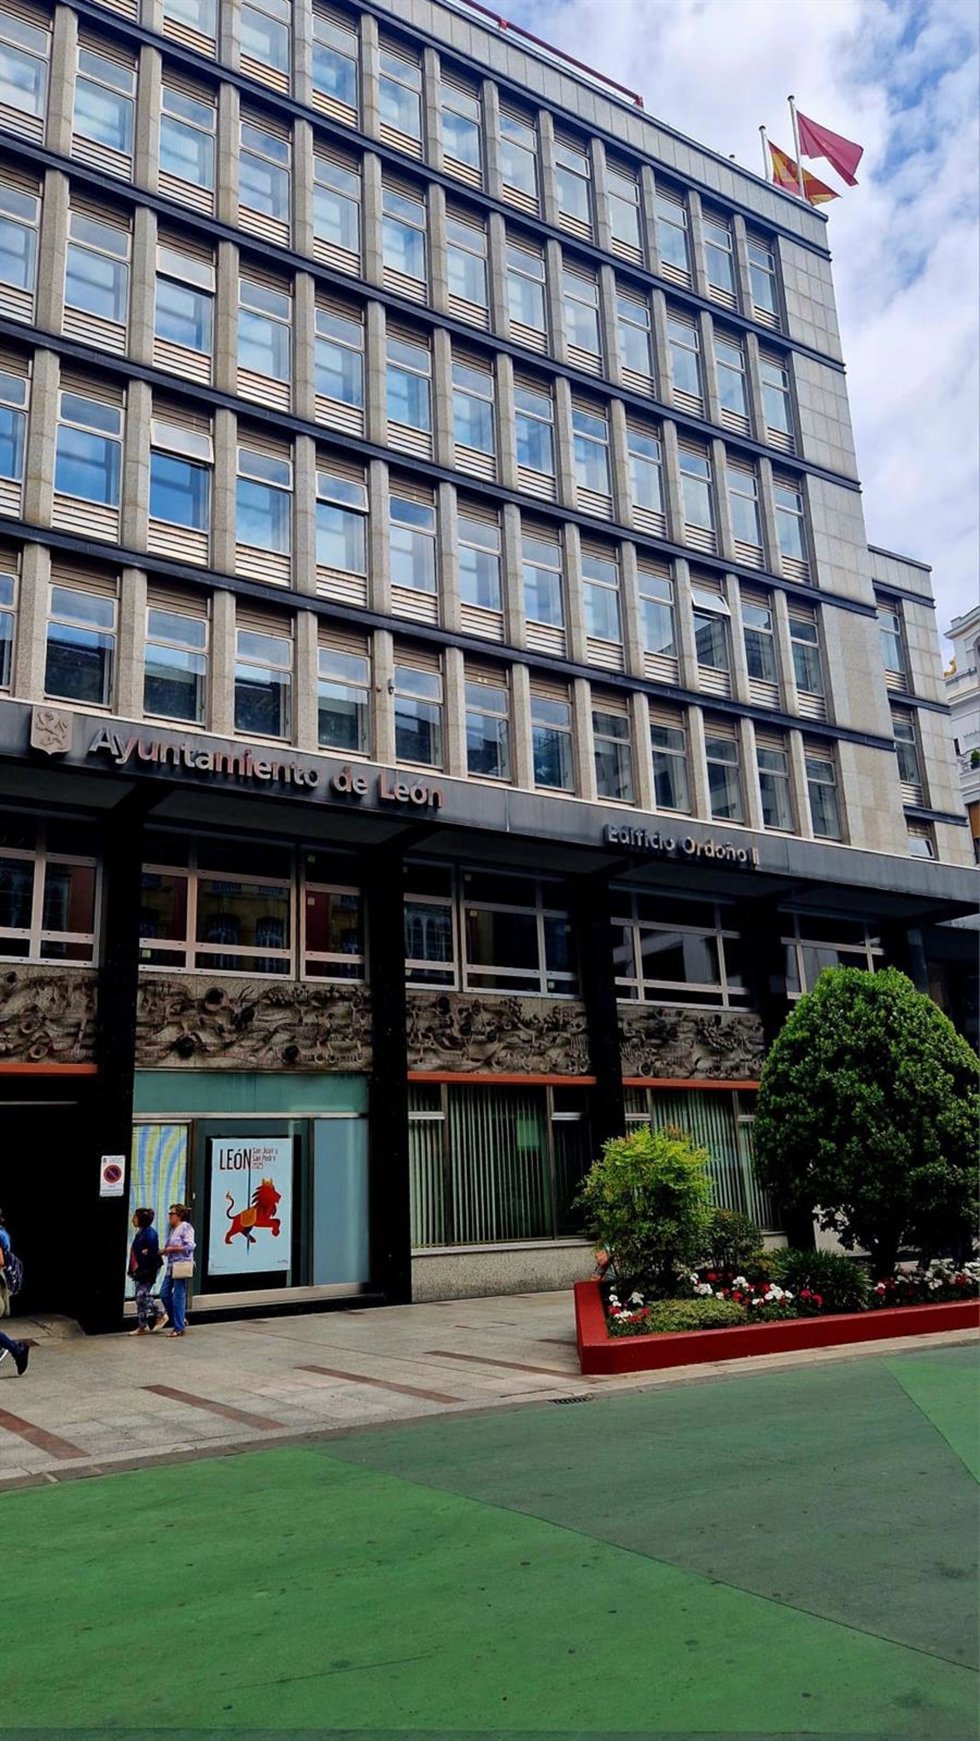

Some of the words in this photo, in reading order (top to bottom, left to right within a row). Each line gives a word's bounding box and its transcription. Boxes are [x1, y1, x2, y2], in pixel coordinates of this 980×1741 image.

[89, 728, 320, 787] Ayuntamiento
[332, 765, 370, 796] de
[378, 772, 446, 810] León
[606, 825, 675, 850] Edificio
[682, 837, 747, 862] Ordoño
